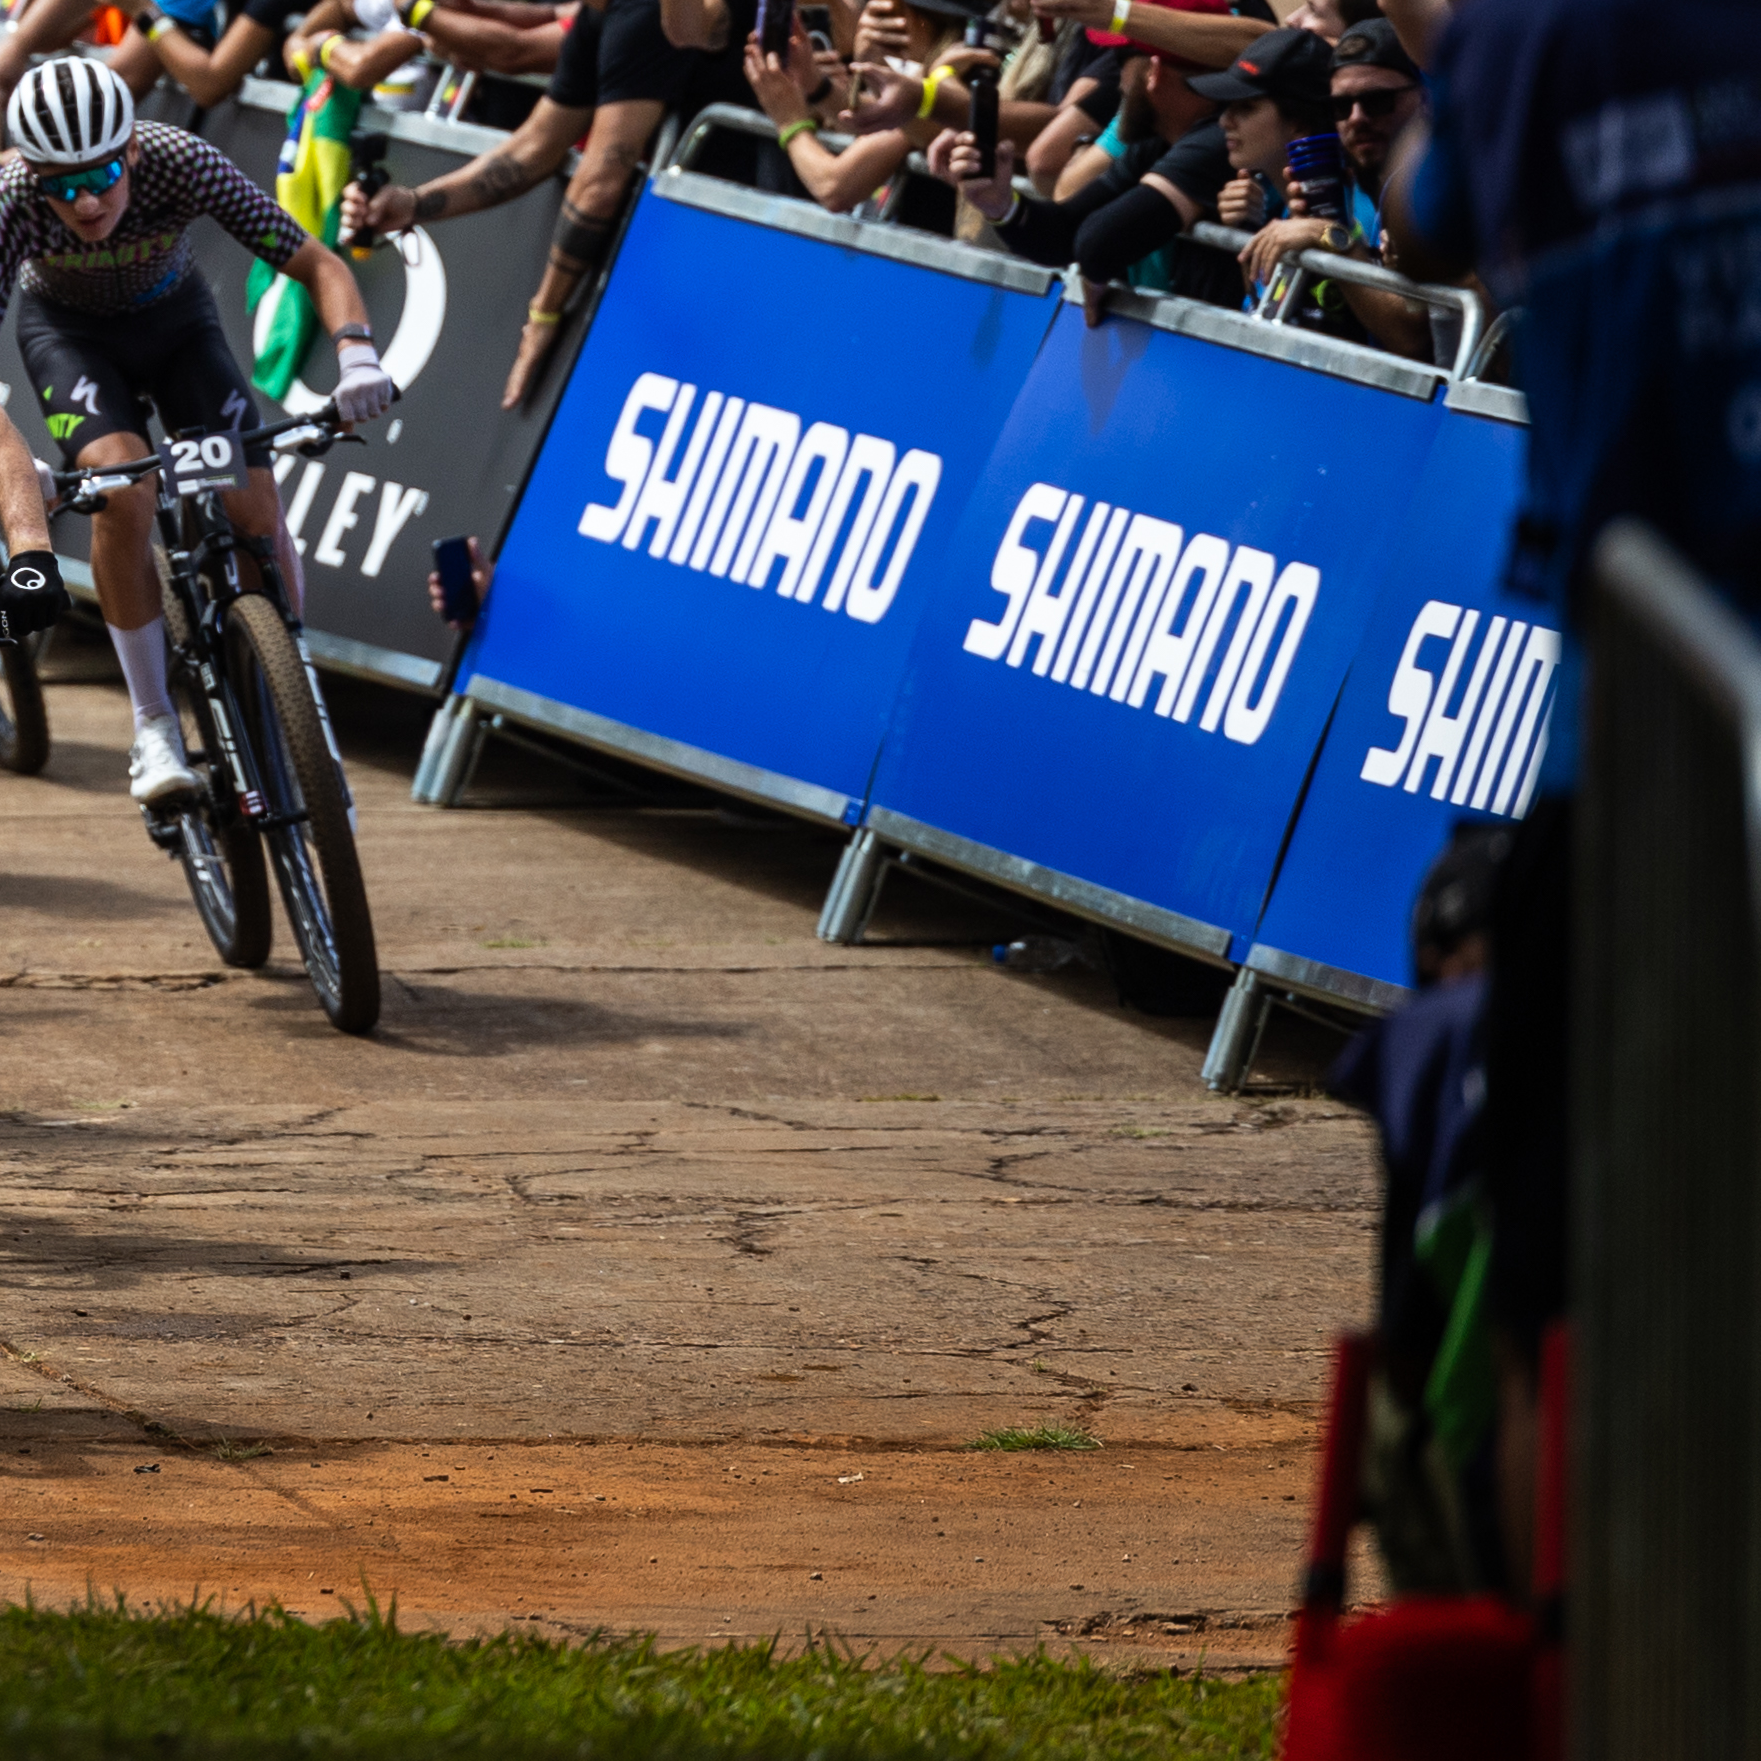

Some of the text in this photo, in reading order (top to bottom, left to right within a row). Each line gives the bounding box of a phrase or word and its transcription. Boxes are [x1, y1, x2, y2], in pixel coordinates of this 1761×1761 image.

[169, 436, 233, 473] 20
[578, 372, 943, 625] SHIMANO
[964, 483, 1321, 745] SHIMANO
[1360, 599, 1562, 820] SHIM
